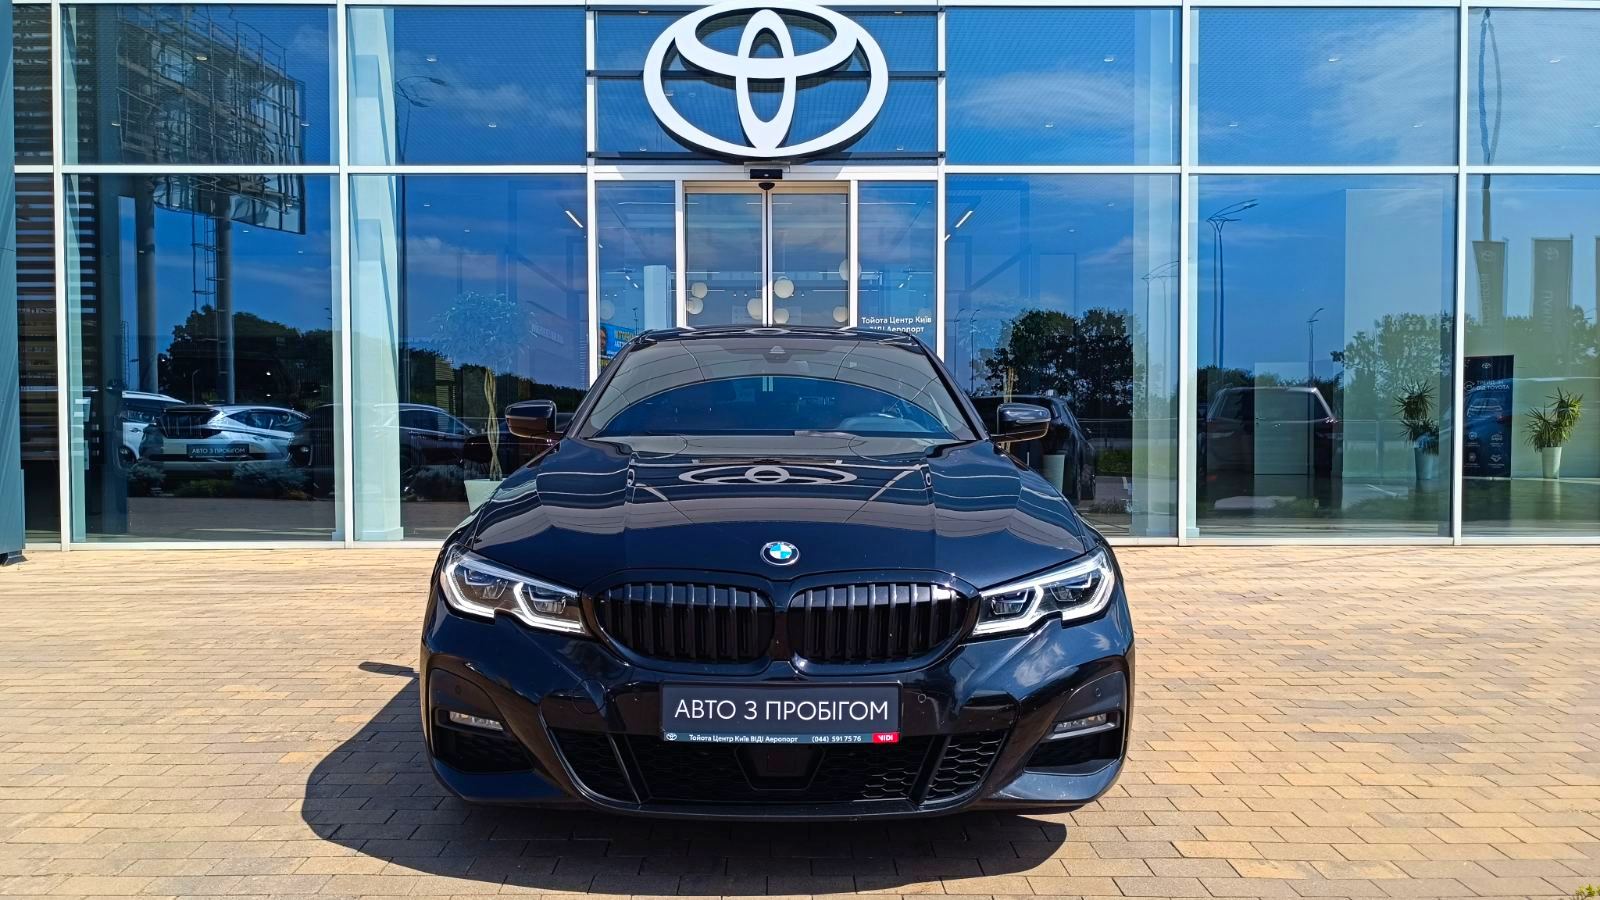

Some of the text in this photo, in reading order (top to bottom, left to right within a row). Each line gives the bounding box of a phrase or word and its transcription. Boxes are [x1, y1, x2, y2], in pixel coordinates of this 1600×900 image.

[861, 315, 932, 325] Тойота Центр Київ
[674, 699, 888, 721] АВТО З ПРОБІГОМ
